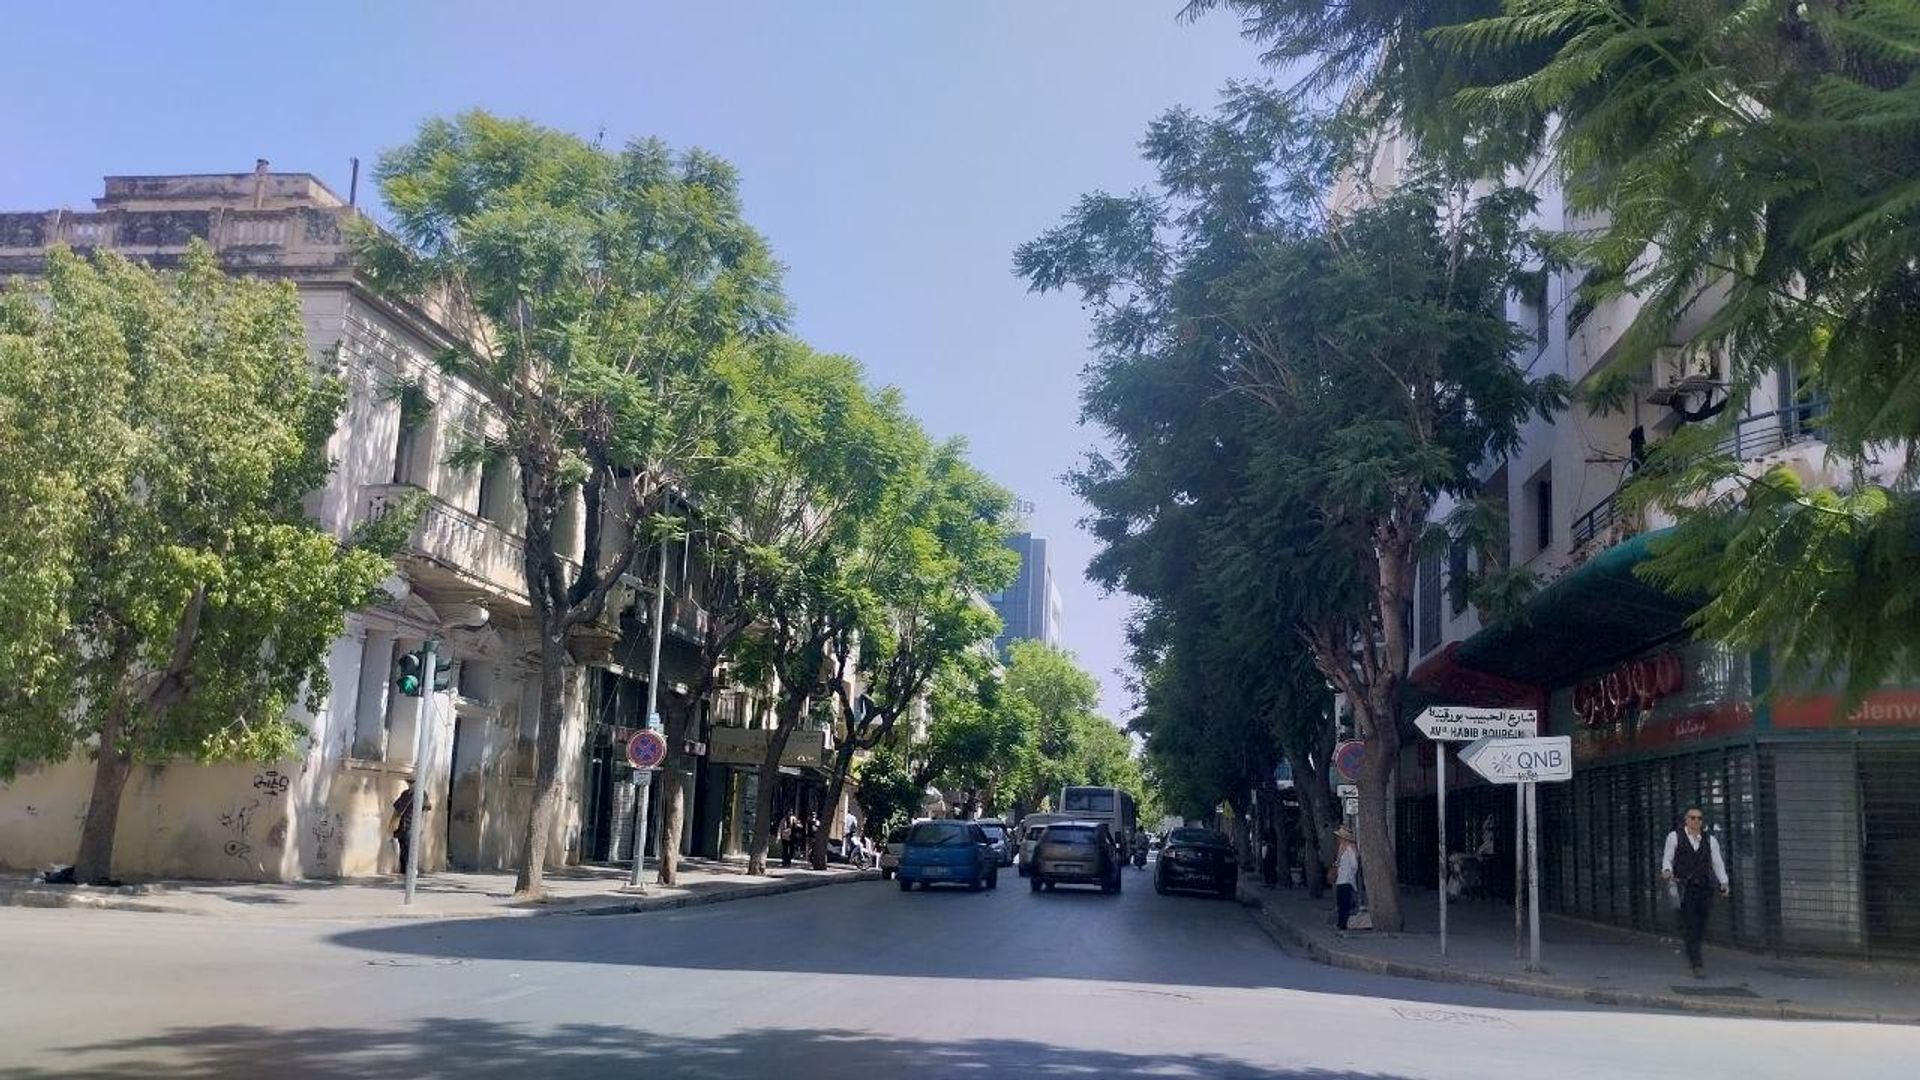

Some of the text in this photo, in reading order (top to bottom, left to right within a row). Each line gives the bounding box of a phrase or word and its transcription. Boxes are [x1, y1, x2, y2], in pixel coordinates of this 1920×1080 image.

[1465, 711, 1506, 724] الحبيب
[1507, 710, 1536, 727] شارع
[1450, 727, 1479, 738] HABIB
[1517, 750, 1562, 769] QNB
